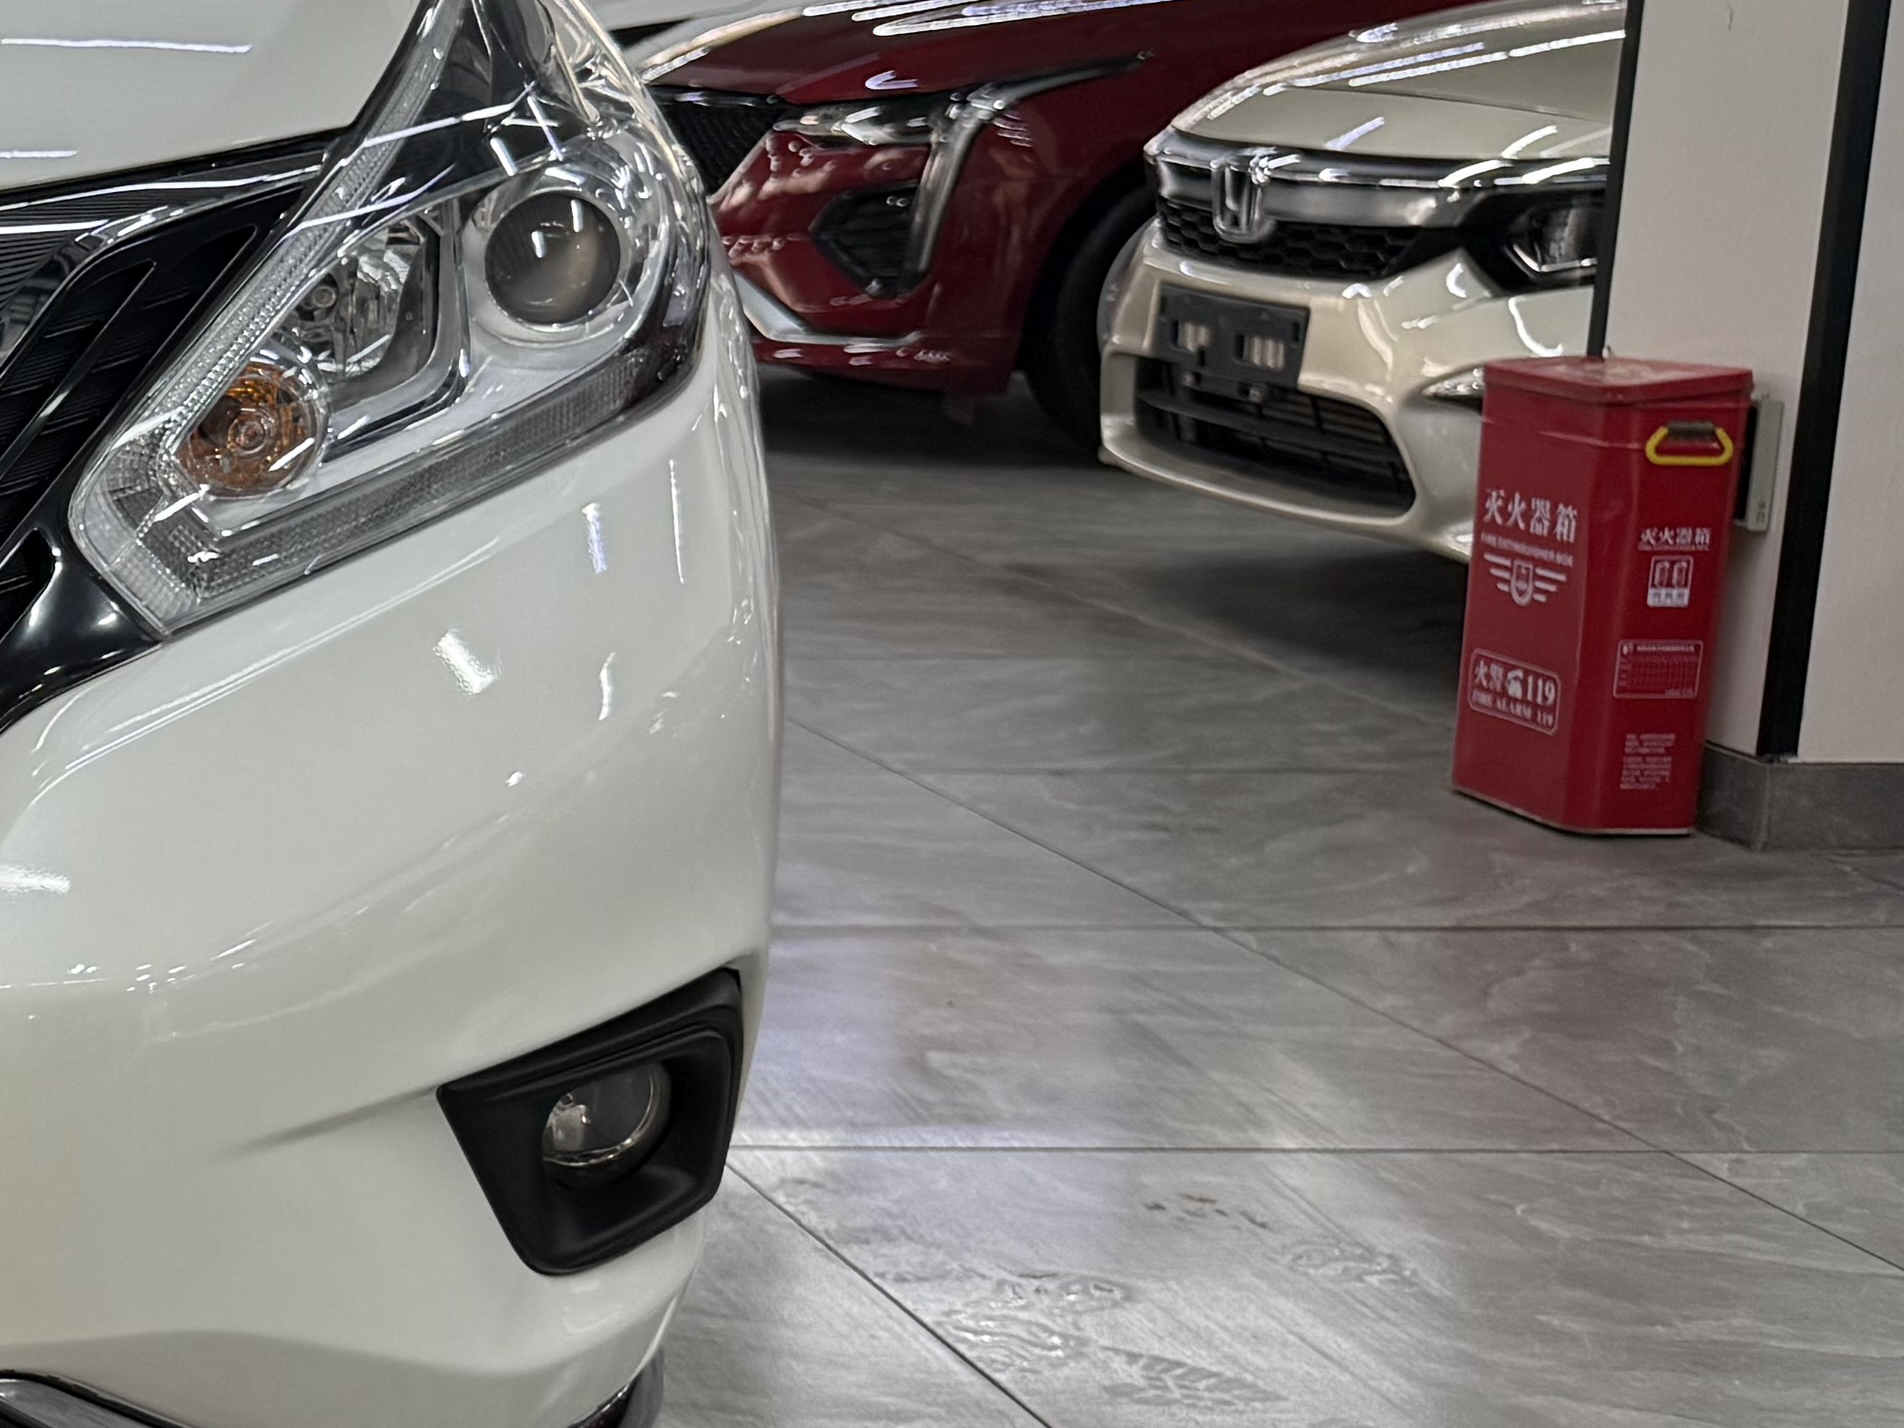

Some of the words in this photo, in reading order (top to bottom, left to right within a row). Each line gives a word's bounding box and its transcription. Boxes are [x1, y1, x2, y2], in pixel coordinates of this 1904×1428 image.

[1483, 489, 1578, 544] 灭火器箱
[1527, 674, 1556, 706] 119
